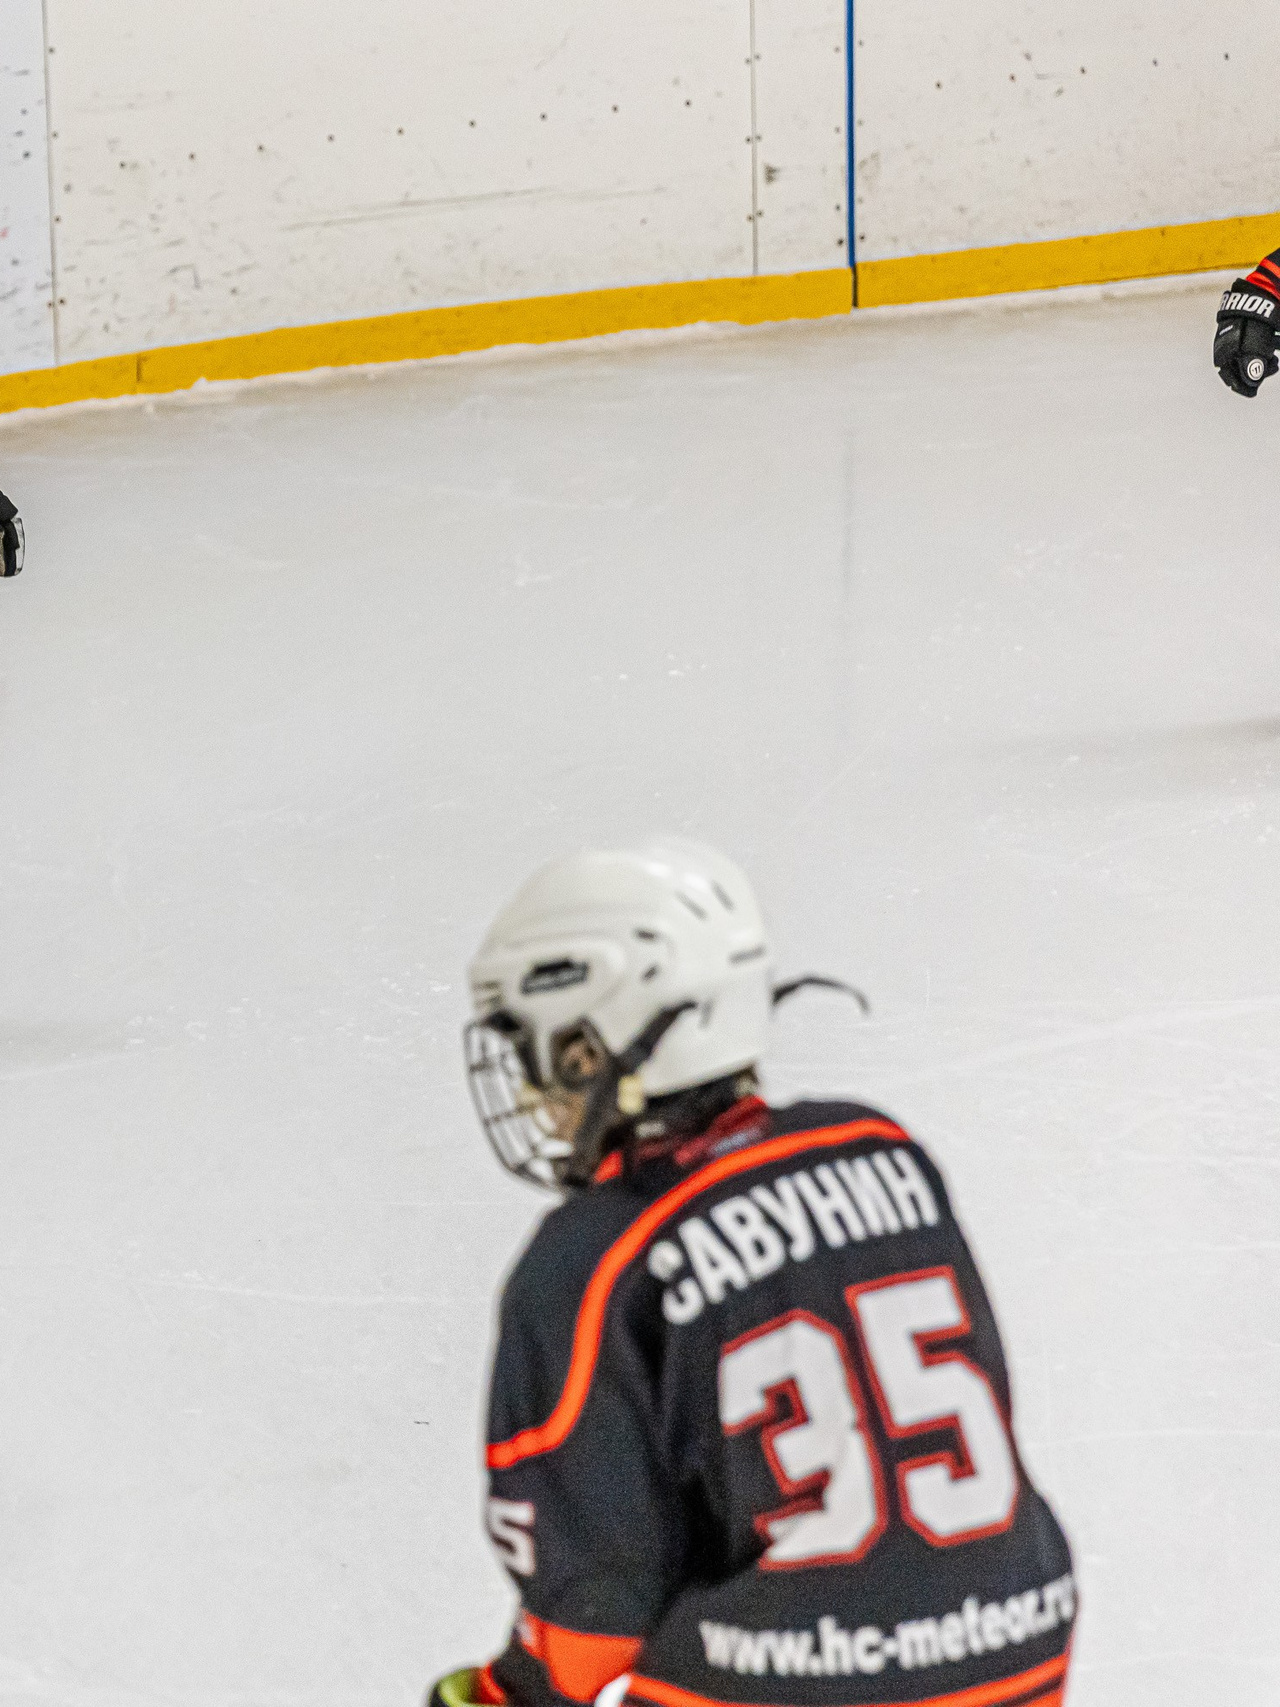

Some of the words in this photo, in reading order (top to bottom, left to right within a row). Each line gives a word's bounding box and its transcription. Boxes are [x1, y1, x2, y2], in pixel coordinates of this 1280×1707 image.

[1220, 292, 1276, 318] RRIOR
[647, 1149, 940, 1325] САВУНИН
[721, 1265, 1018, 1571] 35
